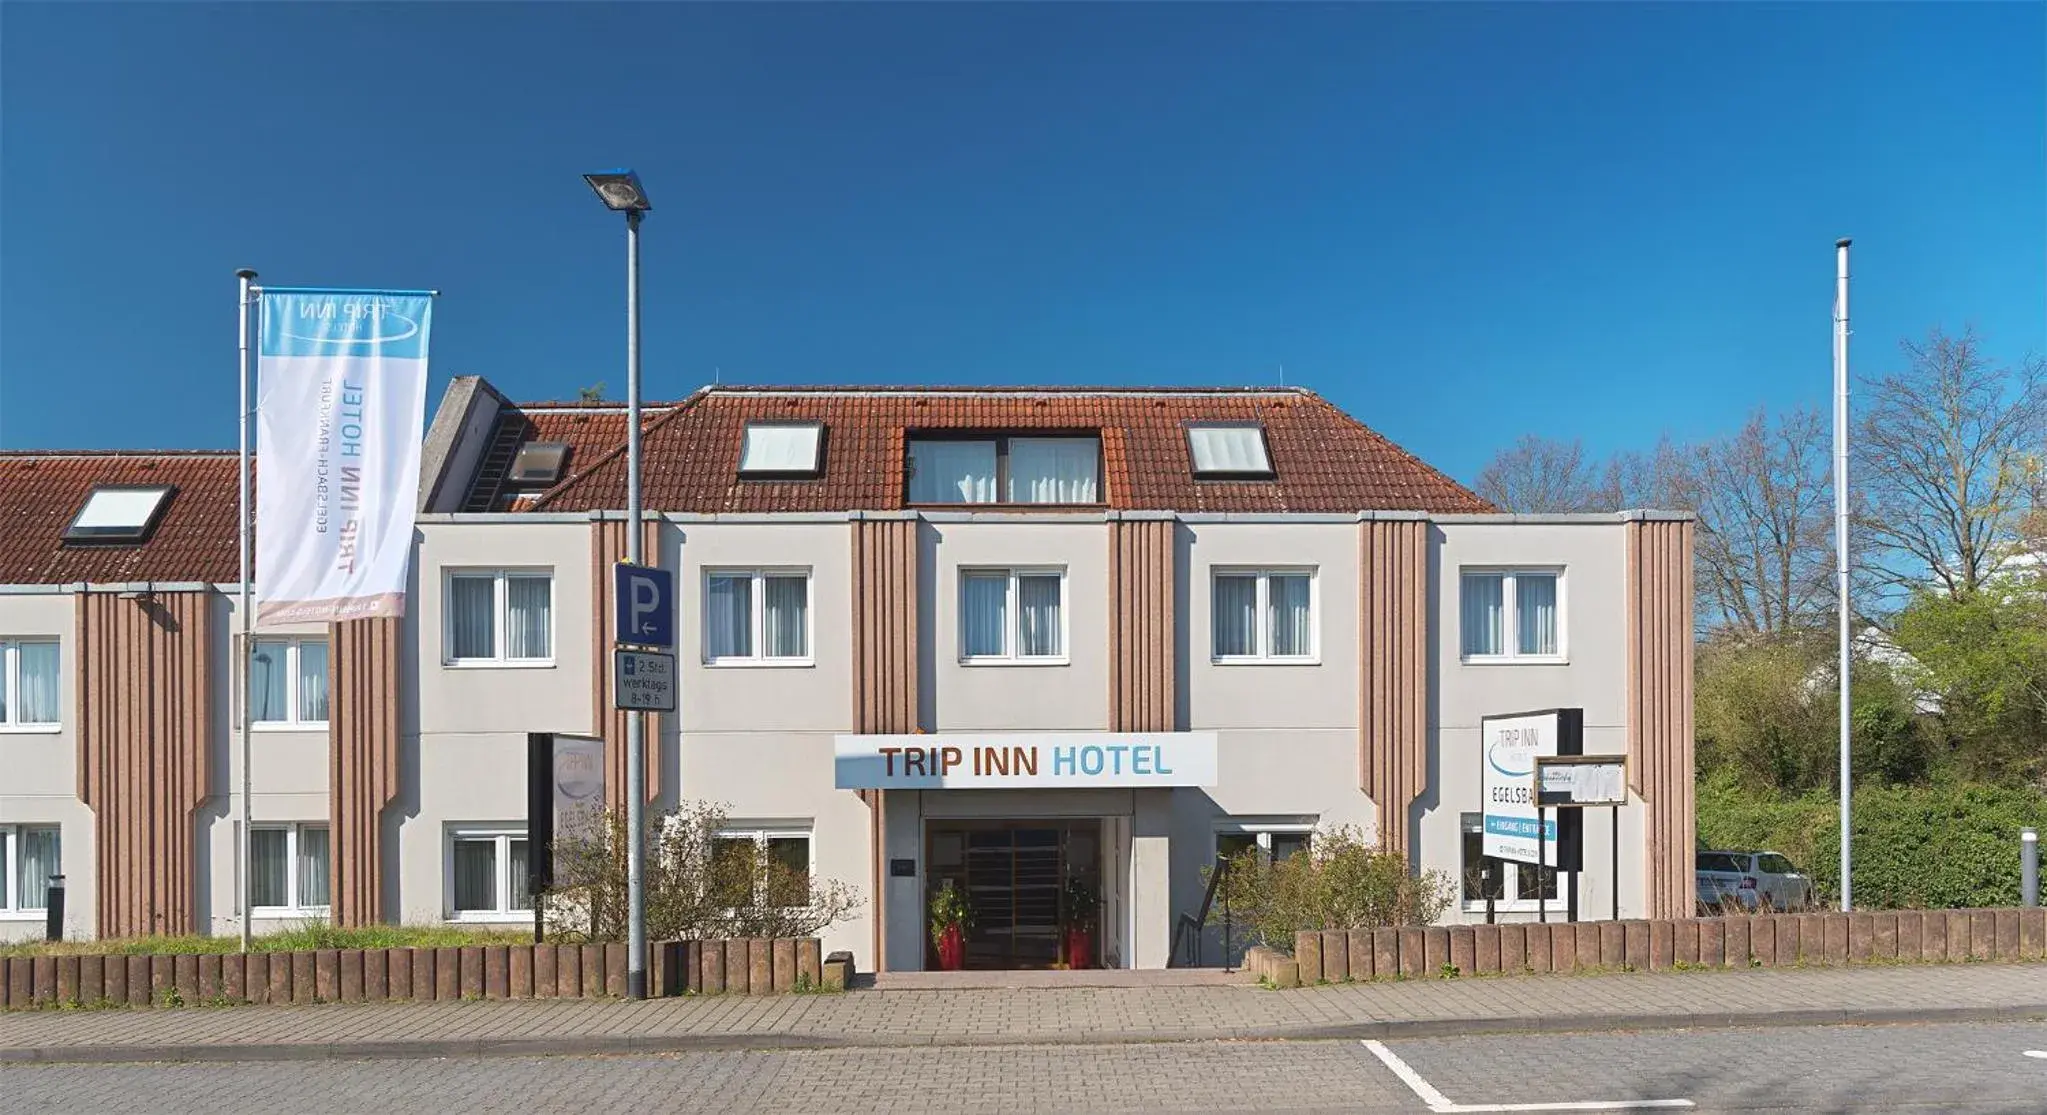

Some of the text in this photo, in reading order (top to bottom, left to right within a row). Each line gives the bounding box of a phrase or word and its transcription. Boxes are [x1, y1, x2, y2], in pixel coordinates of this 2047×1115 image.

[630, 575, 660, 634] P
[639, 660, 645, 673] 2
[623, 677, 668, 694] werktags
[1498, 727, 1539, 748] TRIP INN
[878, 745, 1173, 777] TRIP INN HOTEL
